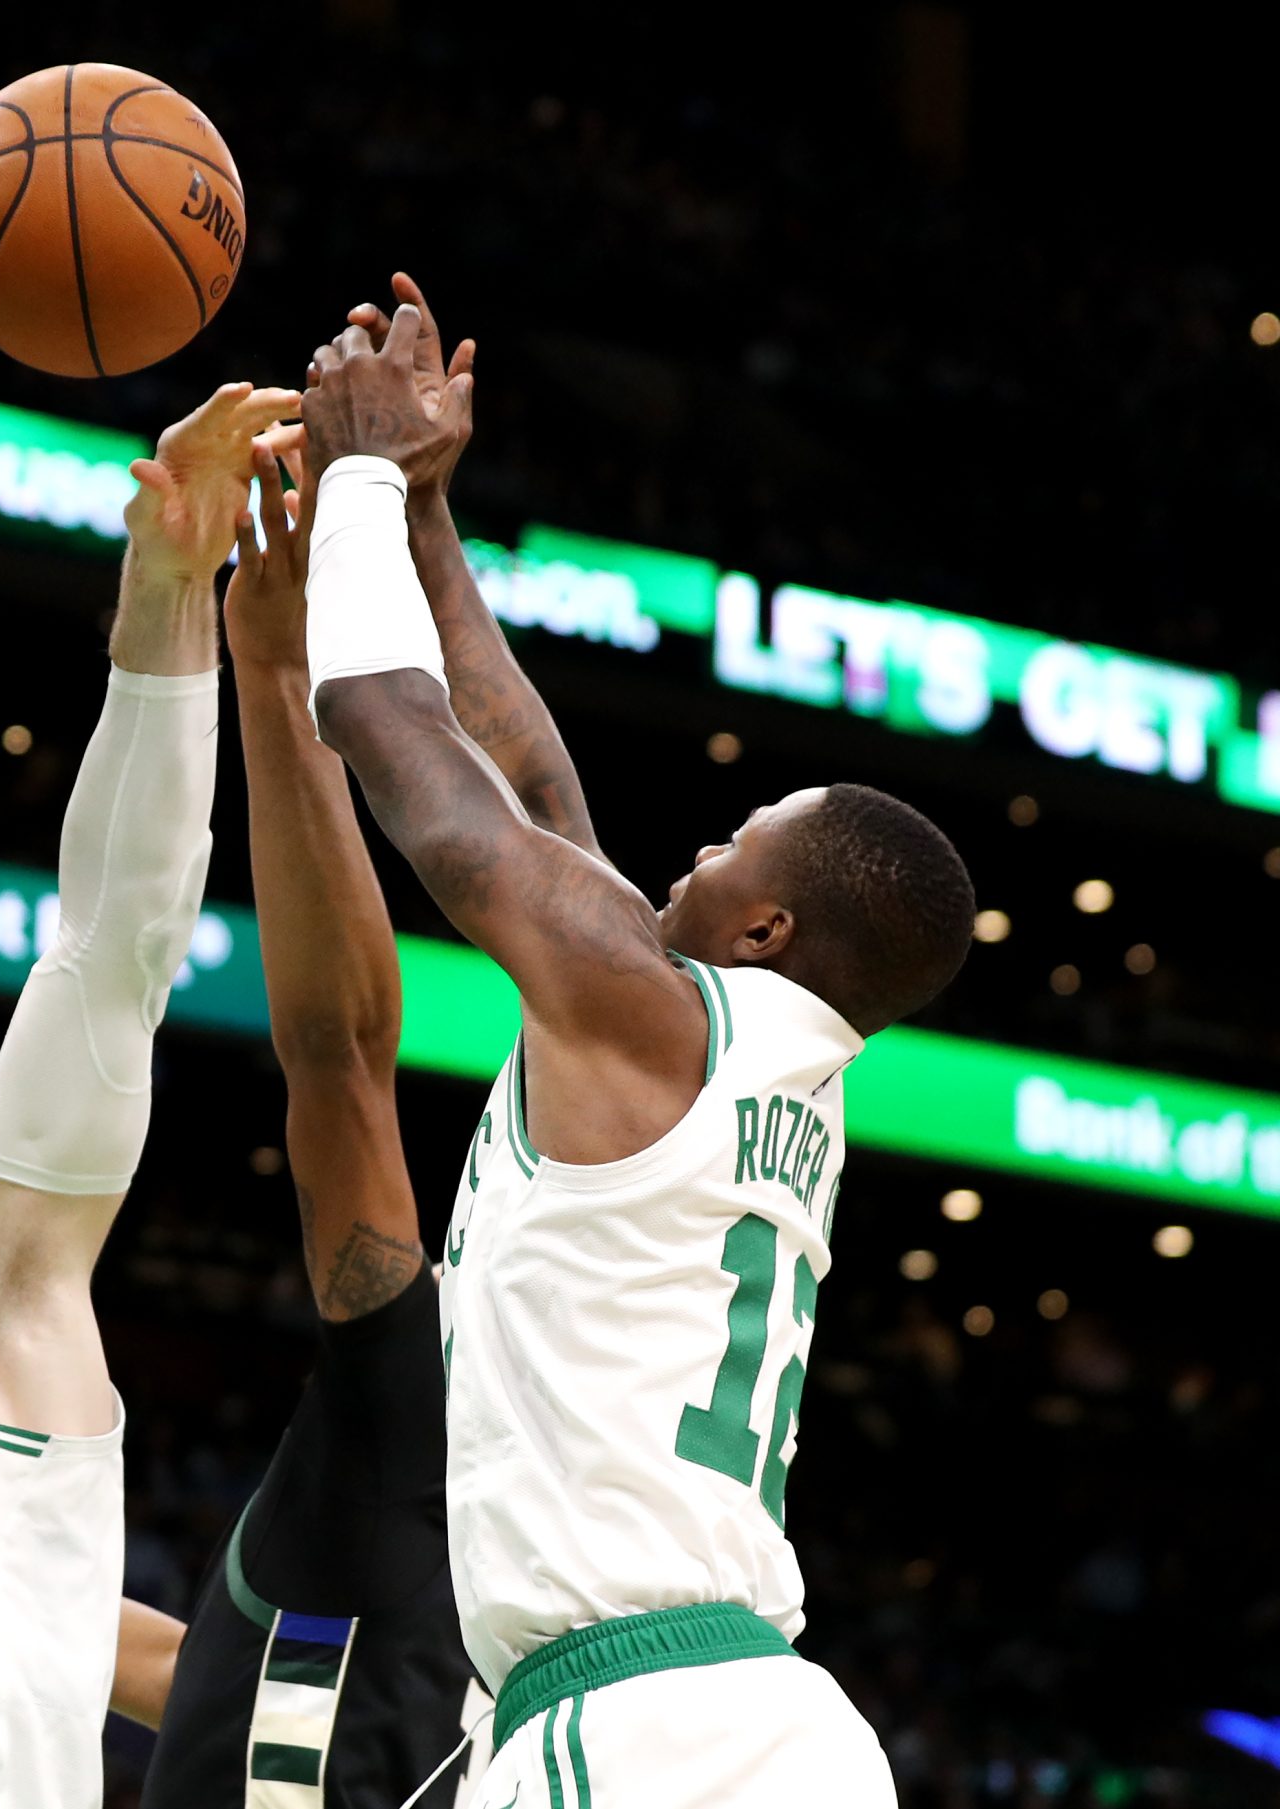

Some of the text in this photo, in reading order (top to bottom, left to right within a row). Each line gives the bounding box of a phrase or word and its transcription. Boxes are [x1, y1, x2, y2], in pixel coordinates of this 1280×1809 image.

[716, 572, 993, 734] LET'S
[1018, 640, 1225, 783] GET
[735, 1094, 830, 1218] ROZIER
